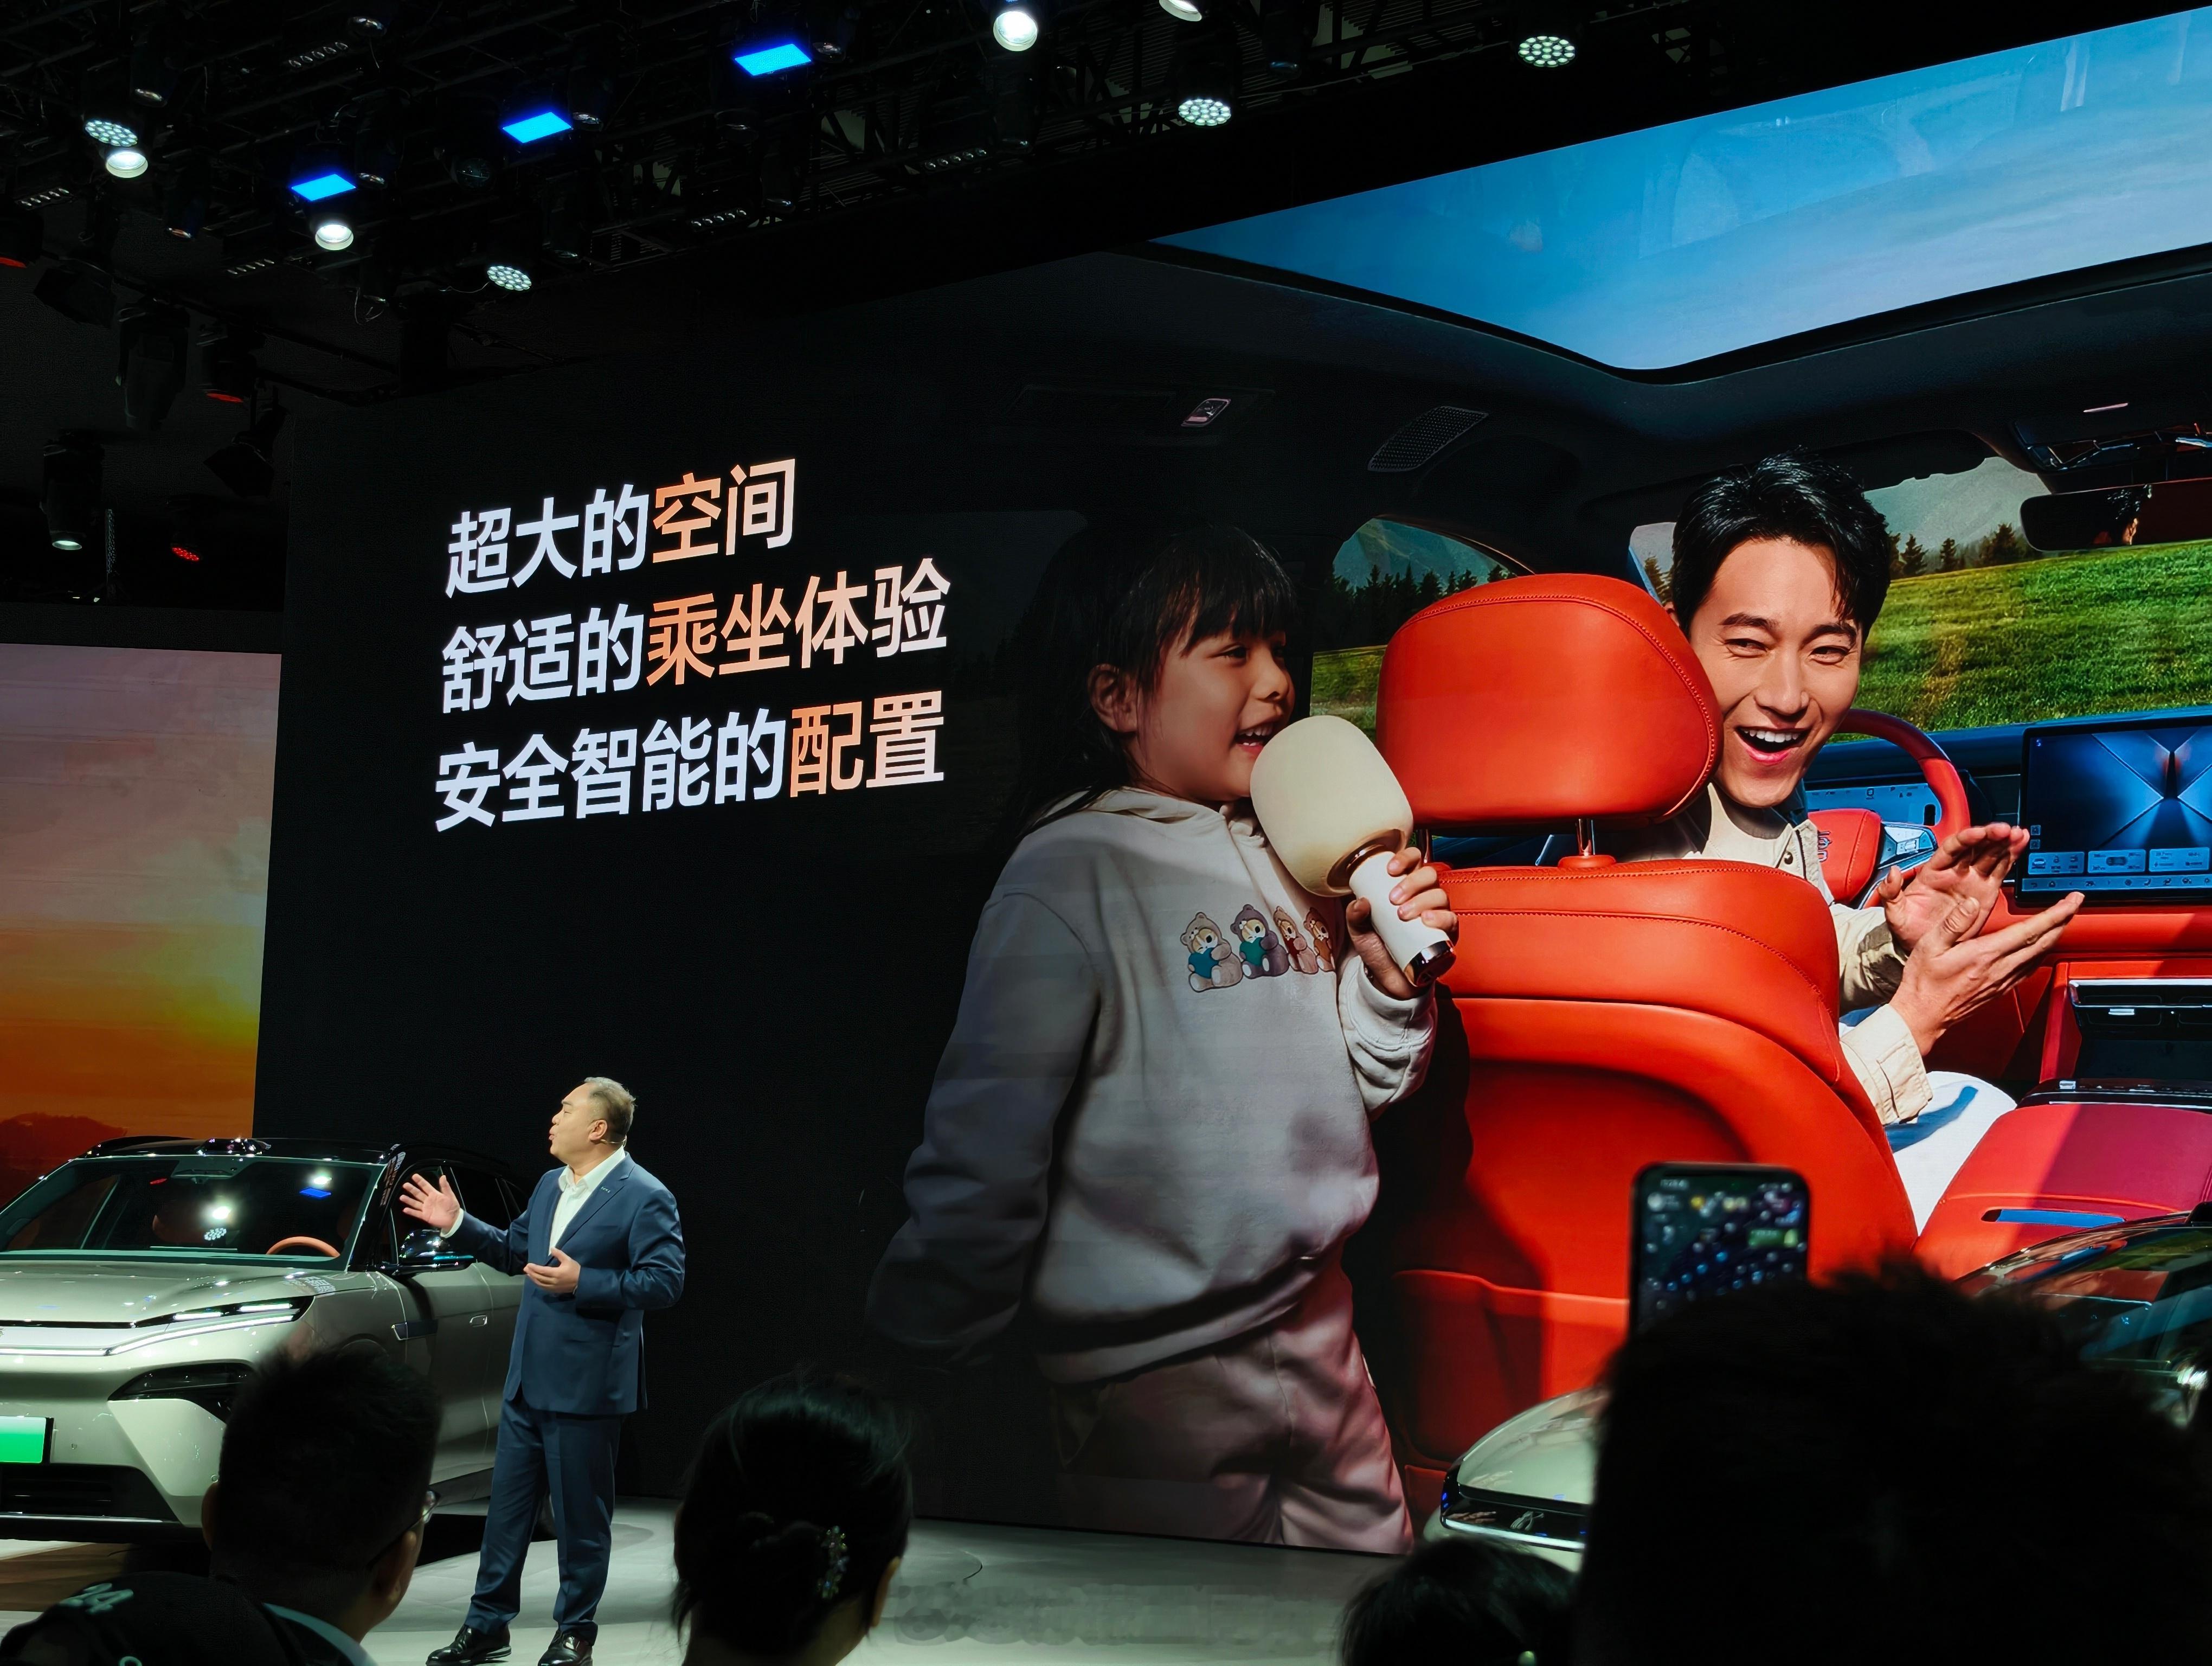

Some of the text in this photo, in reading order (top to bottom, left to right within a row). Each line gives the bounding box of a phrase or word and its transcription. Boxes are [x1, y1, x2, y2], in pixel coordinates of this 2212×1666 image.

[446, 459, 795, 598] 超大的空间
[442, 558, 950, 713] 舒适的乘坐体验
[435, 690, 943, 832] 安全智能的配置
